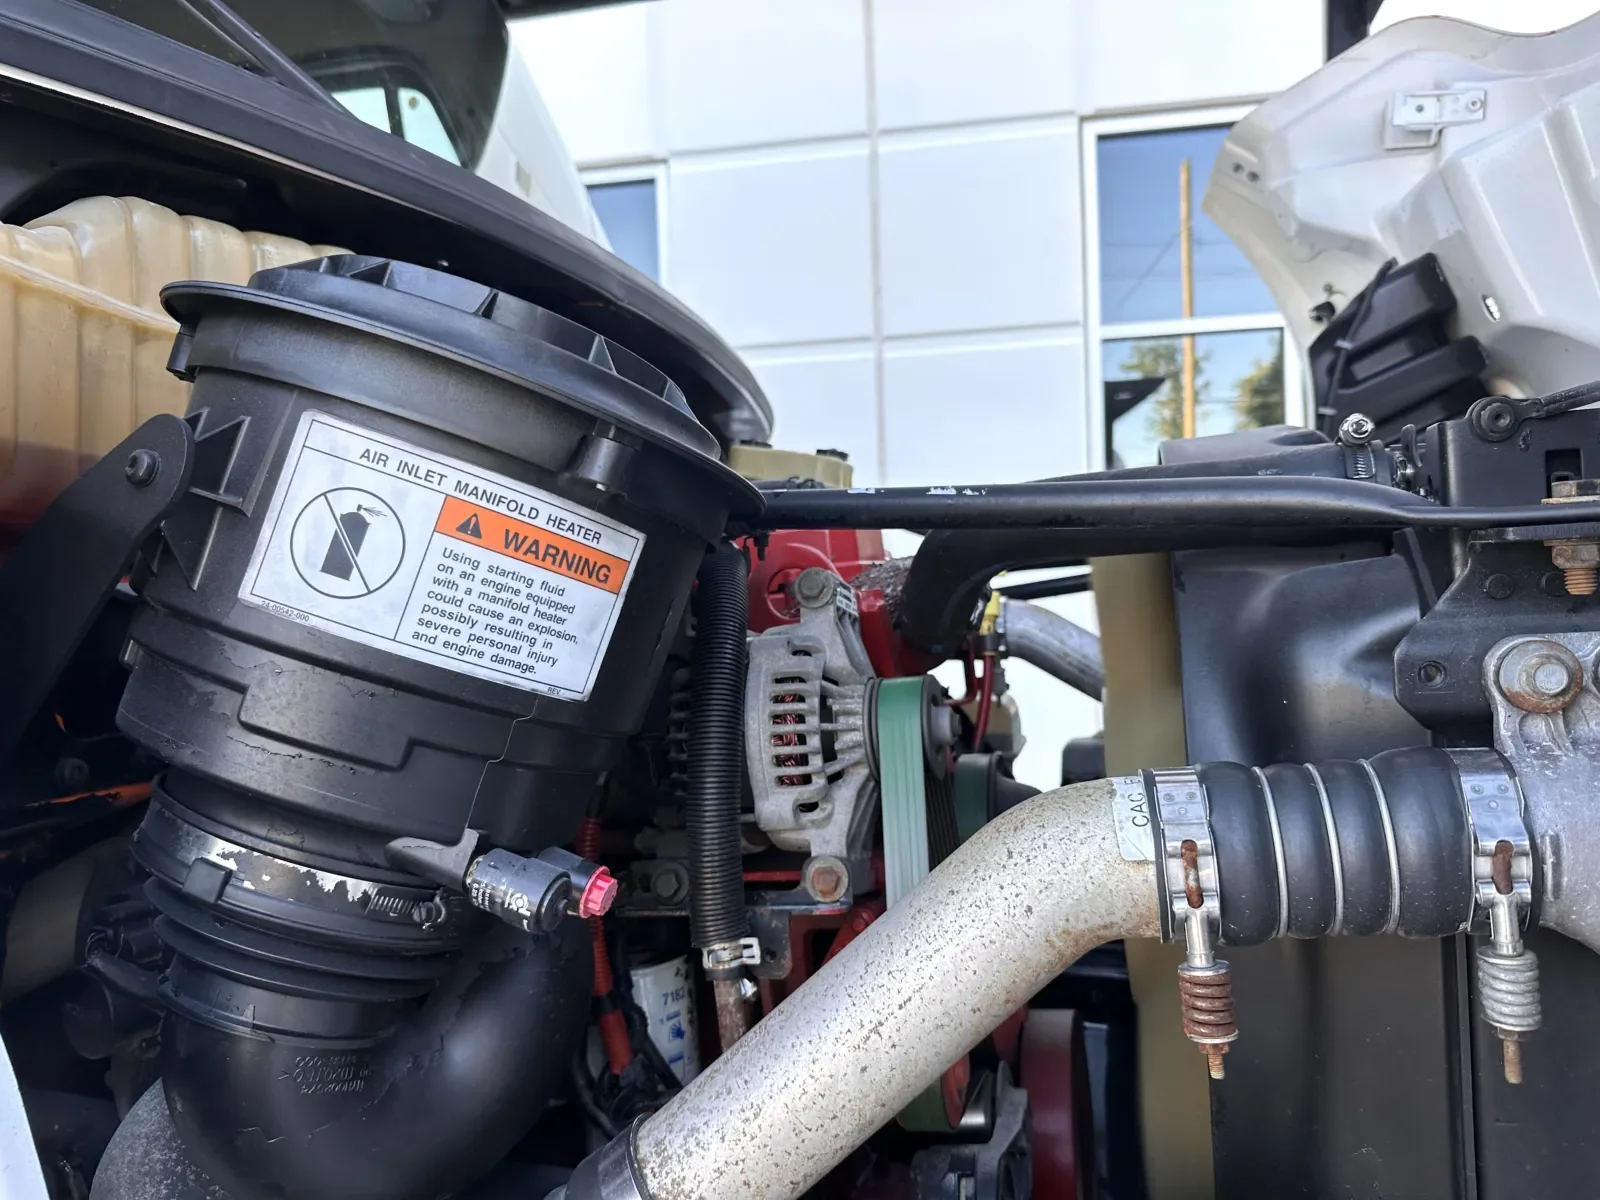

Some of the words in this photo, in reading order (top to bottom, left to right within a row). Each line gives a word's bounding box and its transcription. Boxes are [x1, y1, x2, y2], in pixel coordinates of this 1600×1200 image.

[360, 448, 389, 467] AIR
[396, 460, 448, 486] INLET
[454, 480, 540, 520] MANIFOLD
[546, 514, 602, 544] HEATER
[442, 547, 481, 570] Using
[487, 564, 534, 588] starting
[540, 580, 565, 597] fluid
[504, 528, 611, 584] WARNING
[261, 600, 310, 622] 24-00542-000
[427, 590, 464, 608] could
[468, 603, 504, 620] cause
[508, 616, 523, 627] an
[433, 576, 459, 592] with
[464, 587, 472, 596] a
[478, 591, 530, 614] manifold
[534, 607, 567, 626] heater
[437, 563, 454, 575] on
[459, 570, 475, 582] an
[480, 577, 521, 596] engine
[526, 592, 576, 614] equipped
[417, 617, 461, 637] severe
[467, 633, 522, 655] personal
[527, 648, 558, 668] injury
[421, 603, 478, 629] possibly
[484, 623, 537, 648] resulting
[542, 639, 553, 650] in
[411, 631, 438, 645] and
[442, 640, 485, 659] engine
[490, 653, 537, 674] damage.
[1127, 793, 1150, 827] CAC
